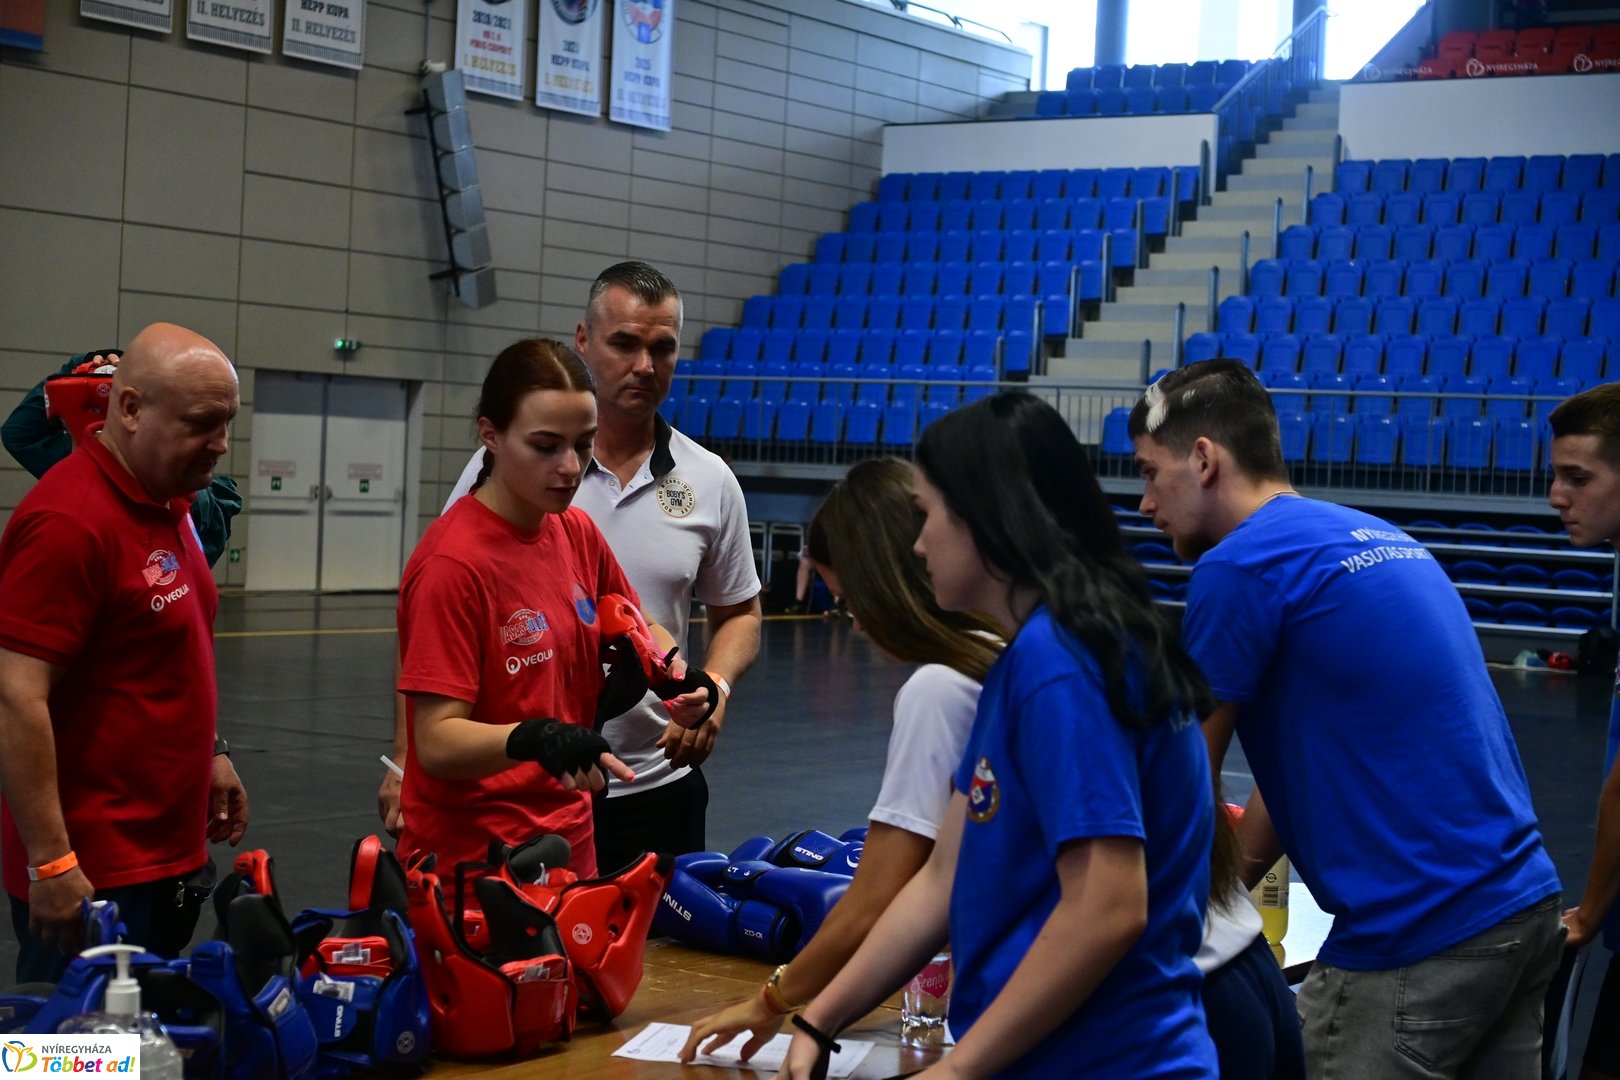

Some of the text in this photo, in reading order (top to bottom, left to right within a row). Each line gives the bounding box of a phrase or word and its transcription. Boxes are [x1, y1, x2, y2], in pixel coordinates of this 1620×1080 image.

[164, 584, 190, 604] VEOLIA
[794, 846, 824, 861] STING
[662, 892, 692, 922] STIN
[334, 1005, 344, 1038] STING
